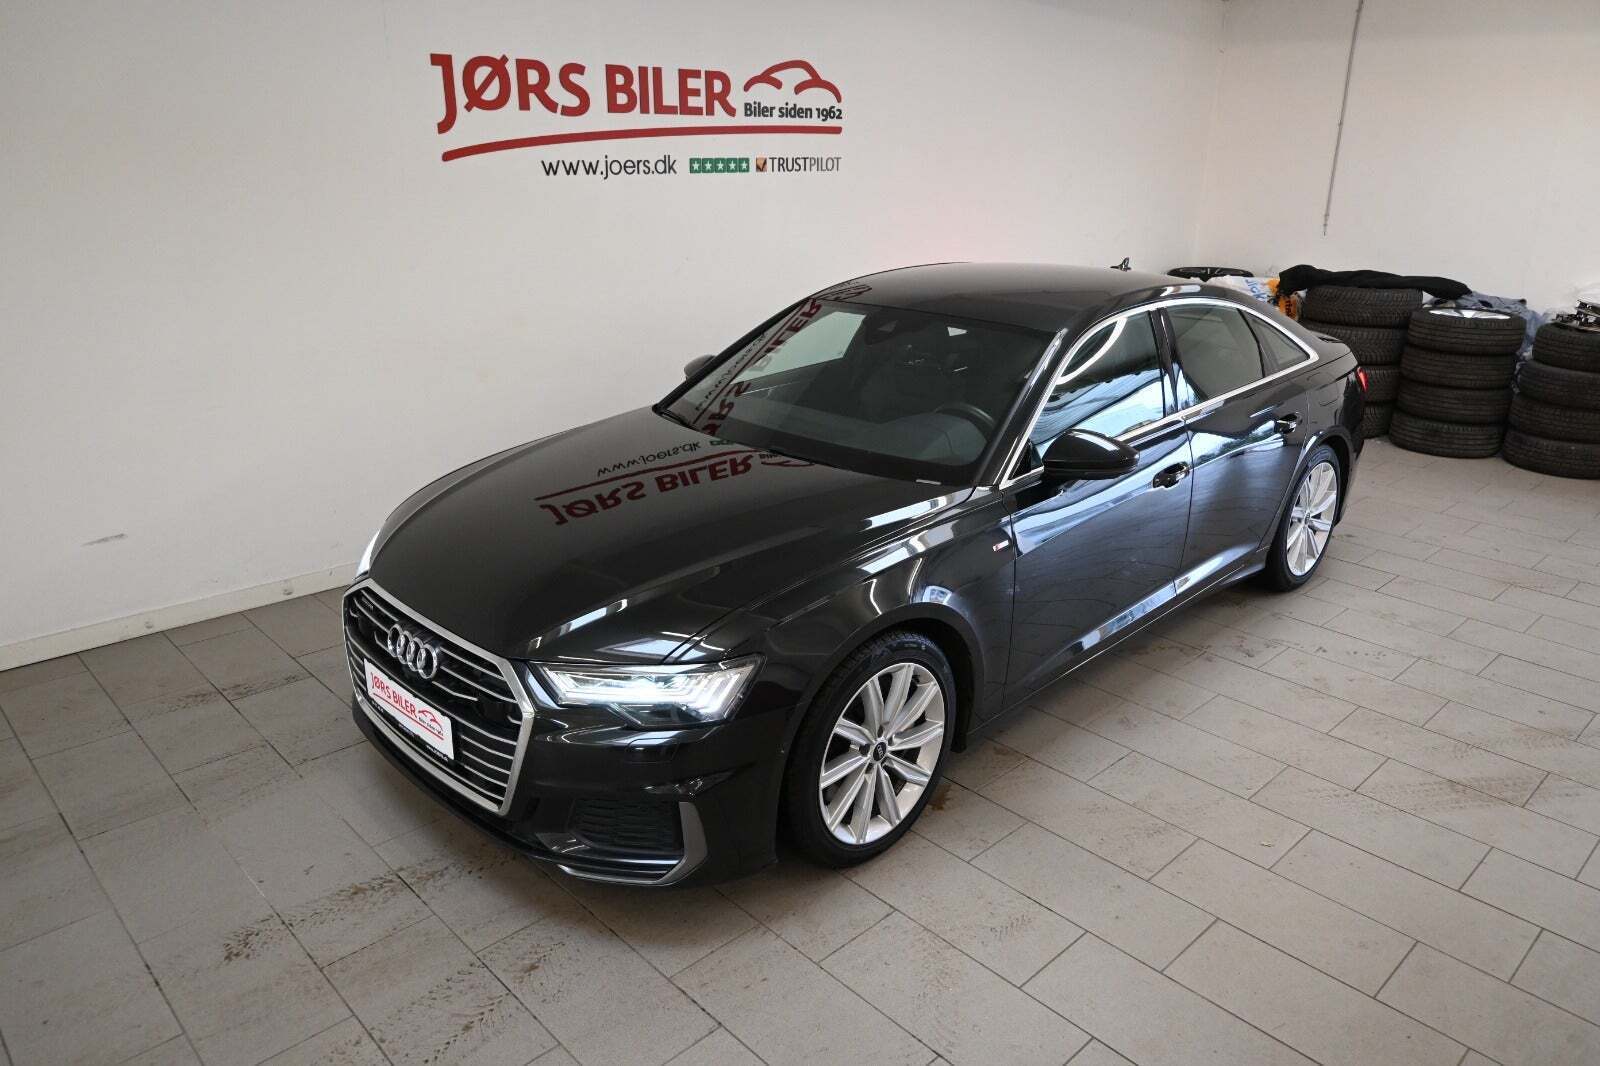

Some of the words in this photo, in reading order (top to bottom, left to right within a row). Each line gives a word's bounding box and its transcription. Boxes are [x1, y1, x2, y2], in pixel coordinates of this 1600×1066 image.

[430, 53, 591, 134] JØRS
[605, 64, 737, 117] BILER
[743, 101, 775, 118] Biler
[777, 103, 813, 119] siden
[815, 106, 843, 121] 1962
[541, 154, 678, 181] www.joers.dk
[769, 156, 842, 173] TRUSTPILOT
[393, 690, 418, 718] BILER
